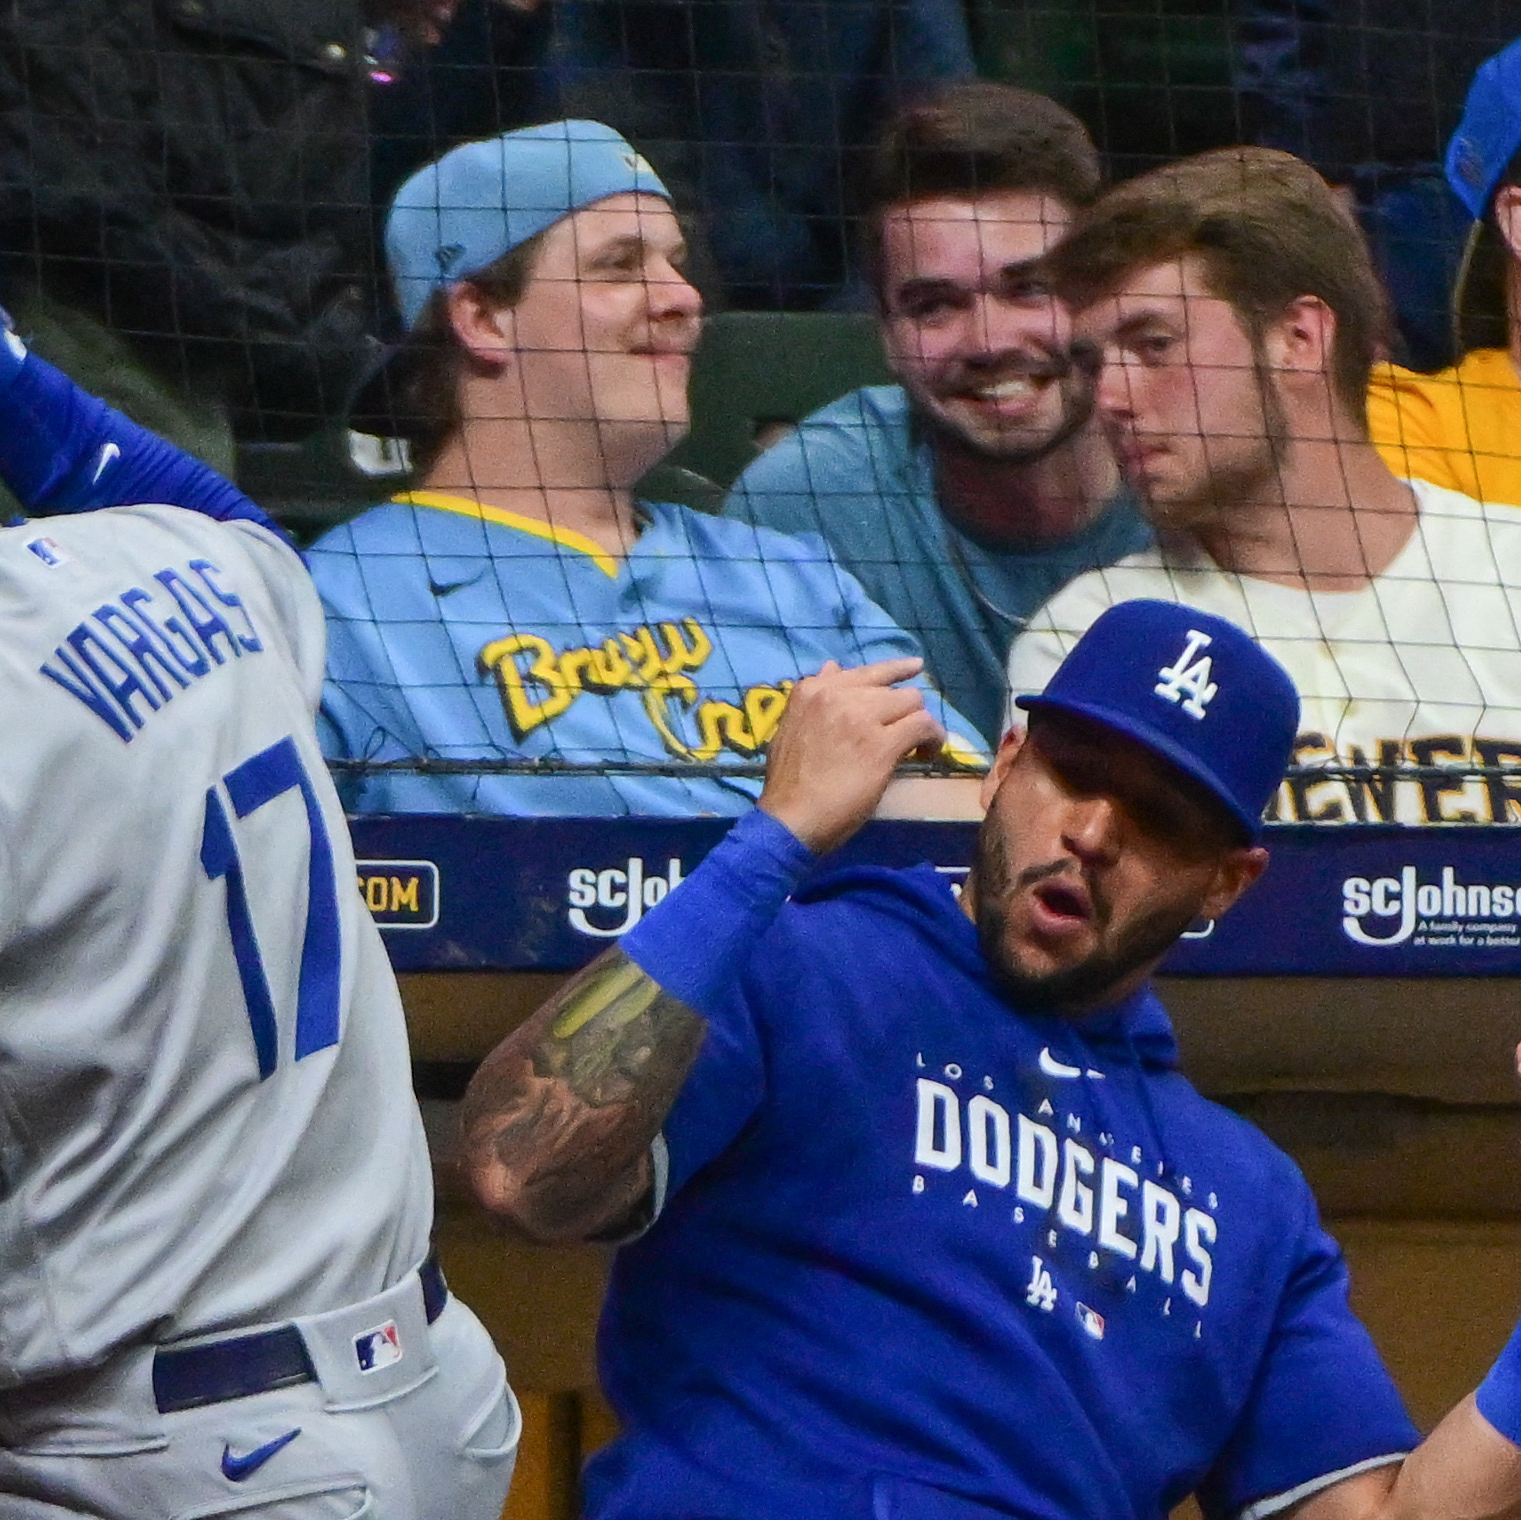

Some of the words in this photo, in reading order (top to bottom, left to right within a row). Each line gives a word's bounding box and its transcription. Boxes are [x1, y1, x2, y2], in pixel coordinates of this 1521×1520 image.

[39, 558, 264, 743] VARGAS
[1153, 628, 1219, 721] LA
[644, 673, 797, 763] Cre
[199, 734, 342, 1083] 17
[915, 1052, 995, 1091] LOS
[911, 1174, 1202, 1339] BASEBALL
[914, 1077, 1218, 1308] DODGERS
[1026, 1254, 1058, 1312] LA
